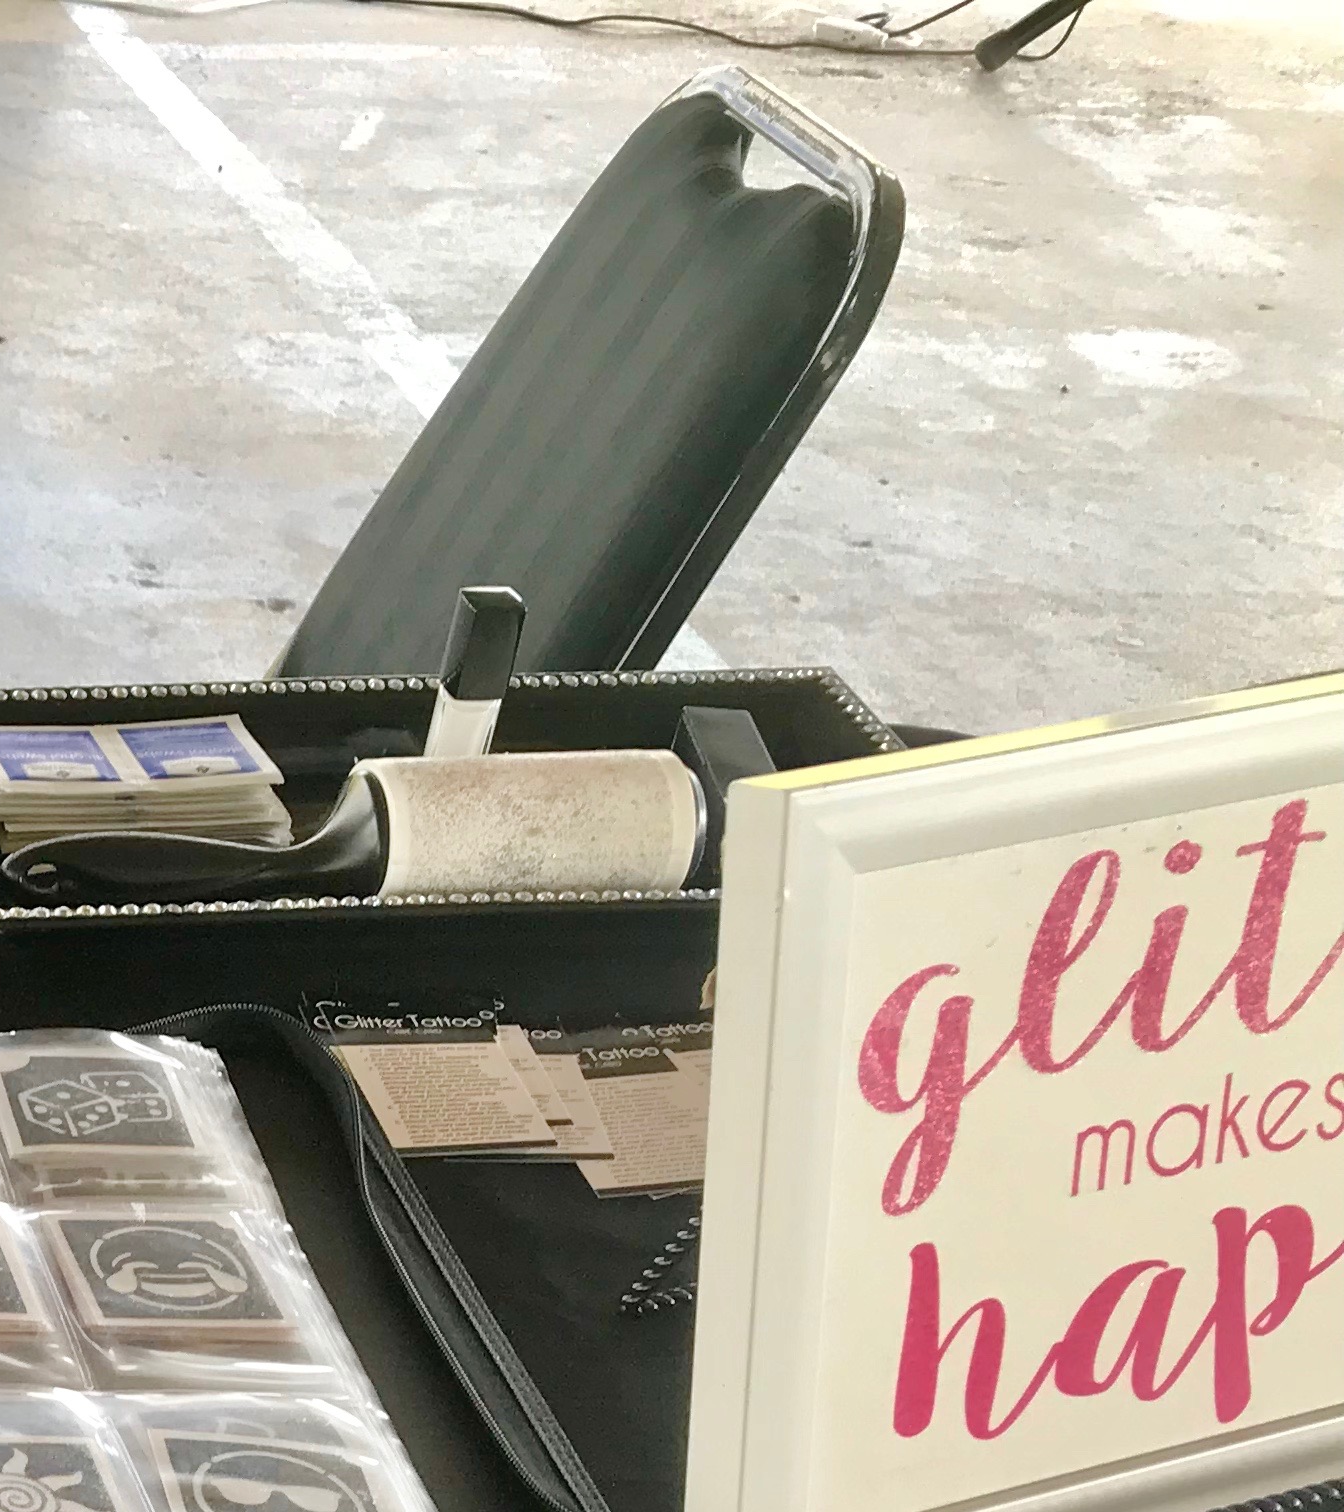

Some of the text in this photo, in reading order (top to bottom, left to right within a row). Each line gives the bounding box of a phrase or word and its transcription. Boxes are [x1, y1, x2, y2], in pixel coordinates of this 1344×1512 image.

[334, 1013, 483, 1029] Glitter Tattoo
[640, 1022, 713, 1038] Tattoo
[582, 1047, 659, 1061] Tattoo
[1069, 1071, 1344, 1198] makes
